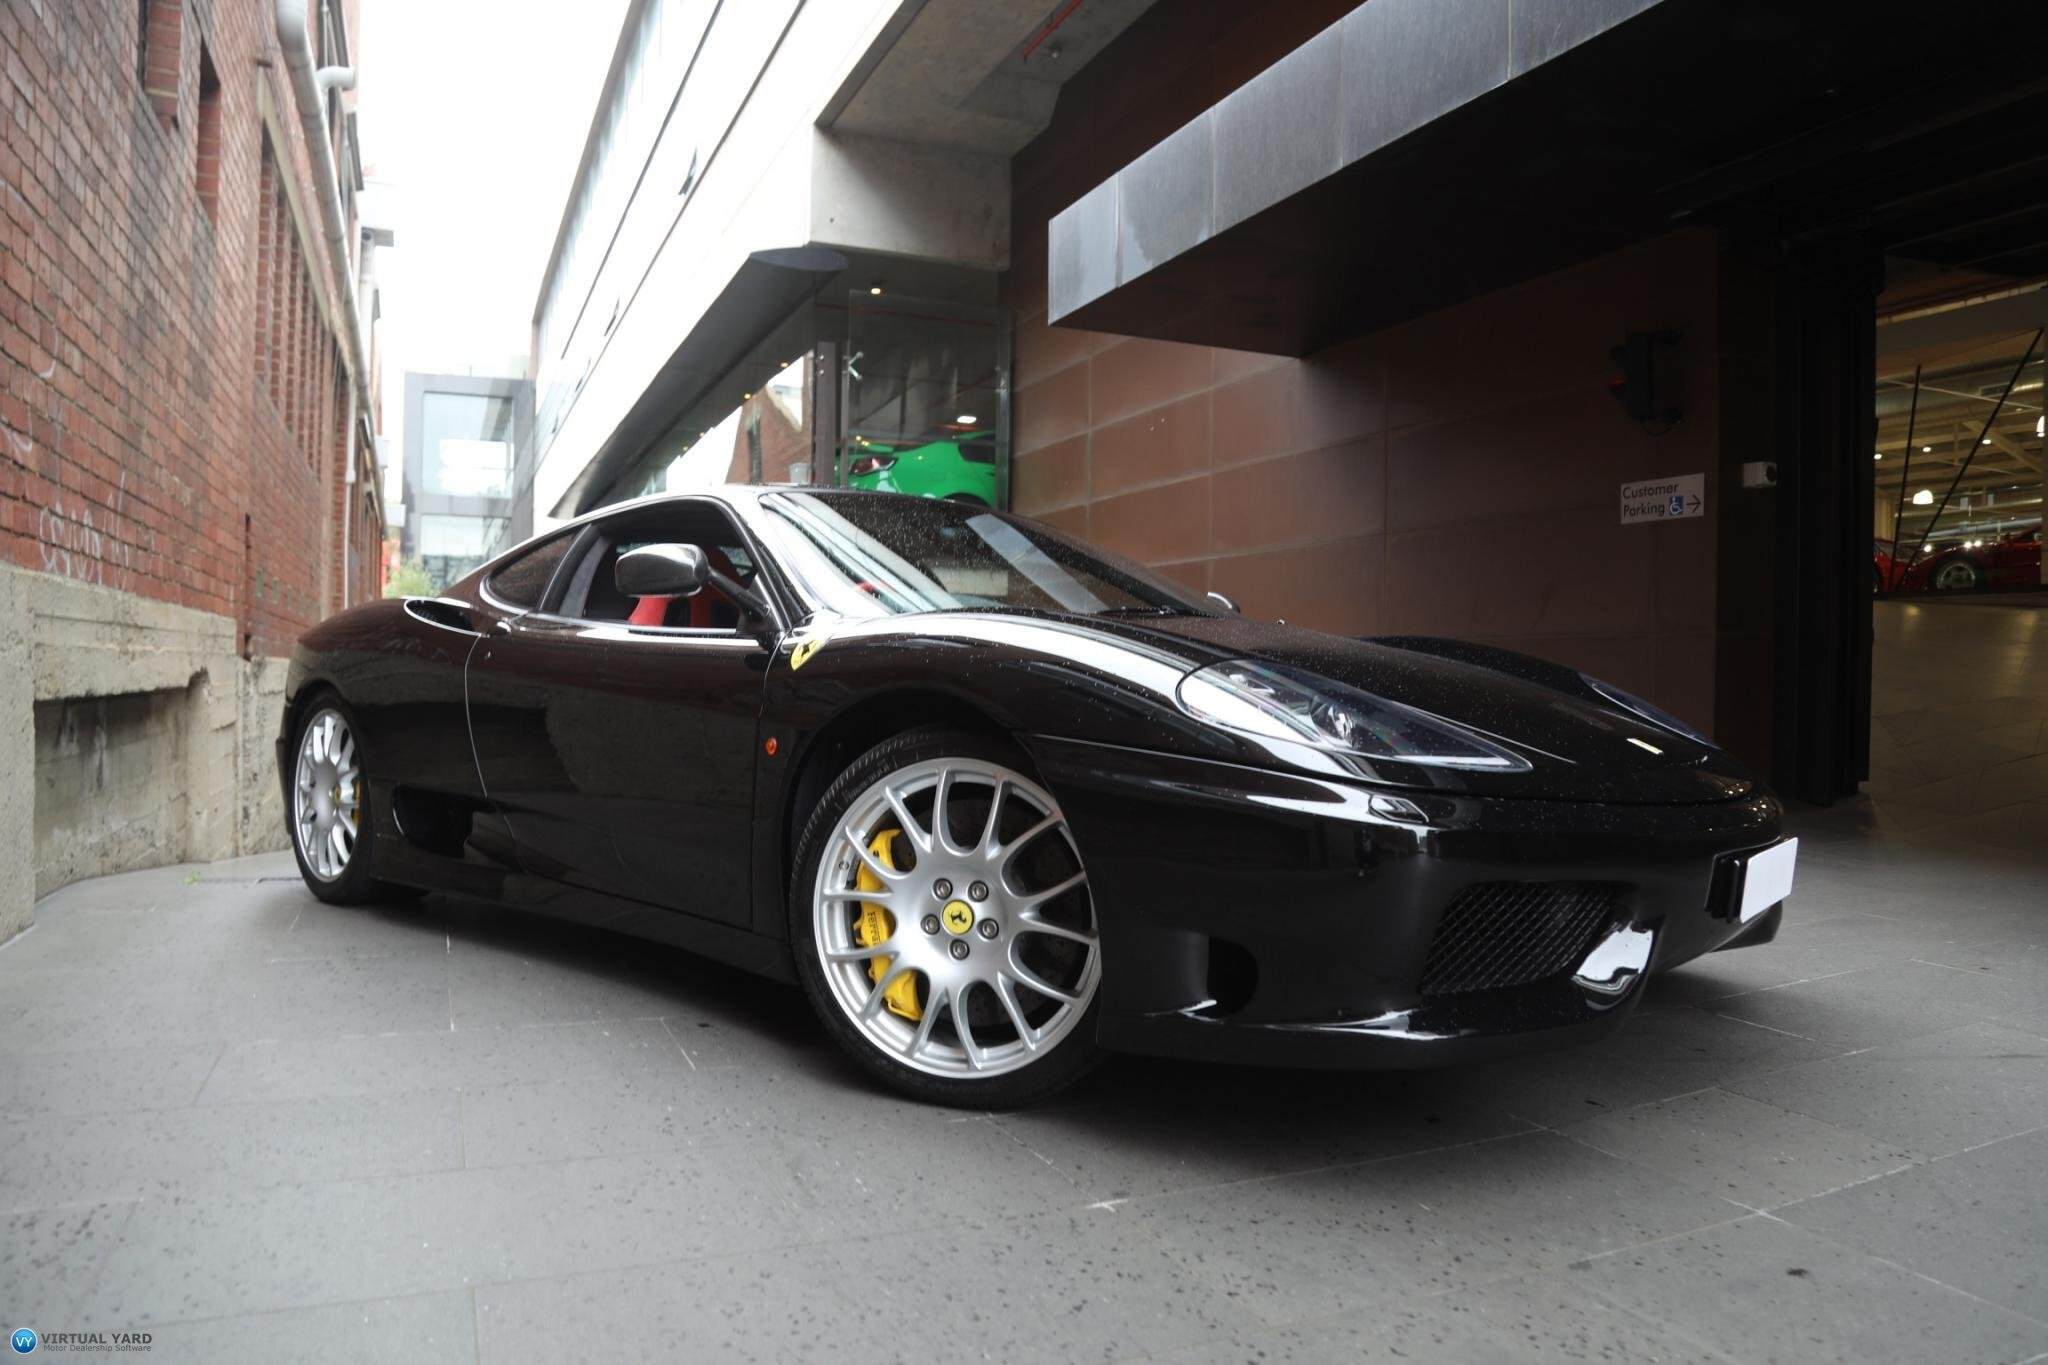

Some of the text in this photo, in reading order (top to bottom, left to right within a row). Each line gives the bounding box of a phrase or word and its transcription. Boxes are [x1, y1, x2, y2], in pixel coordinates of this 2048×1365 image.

[1622, 483, 1679, 499] Customer
[1623, 502, 1665, 517] Parking
[867, 911, 881, 946] Ferra
